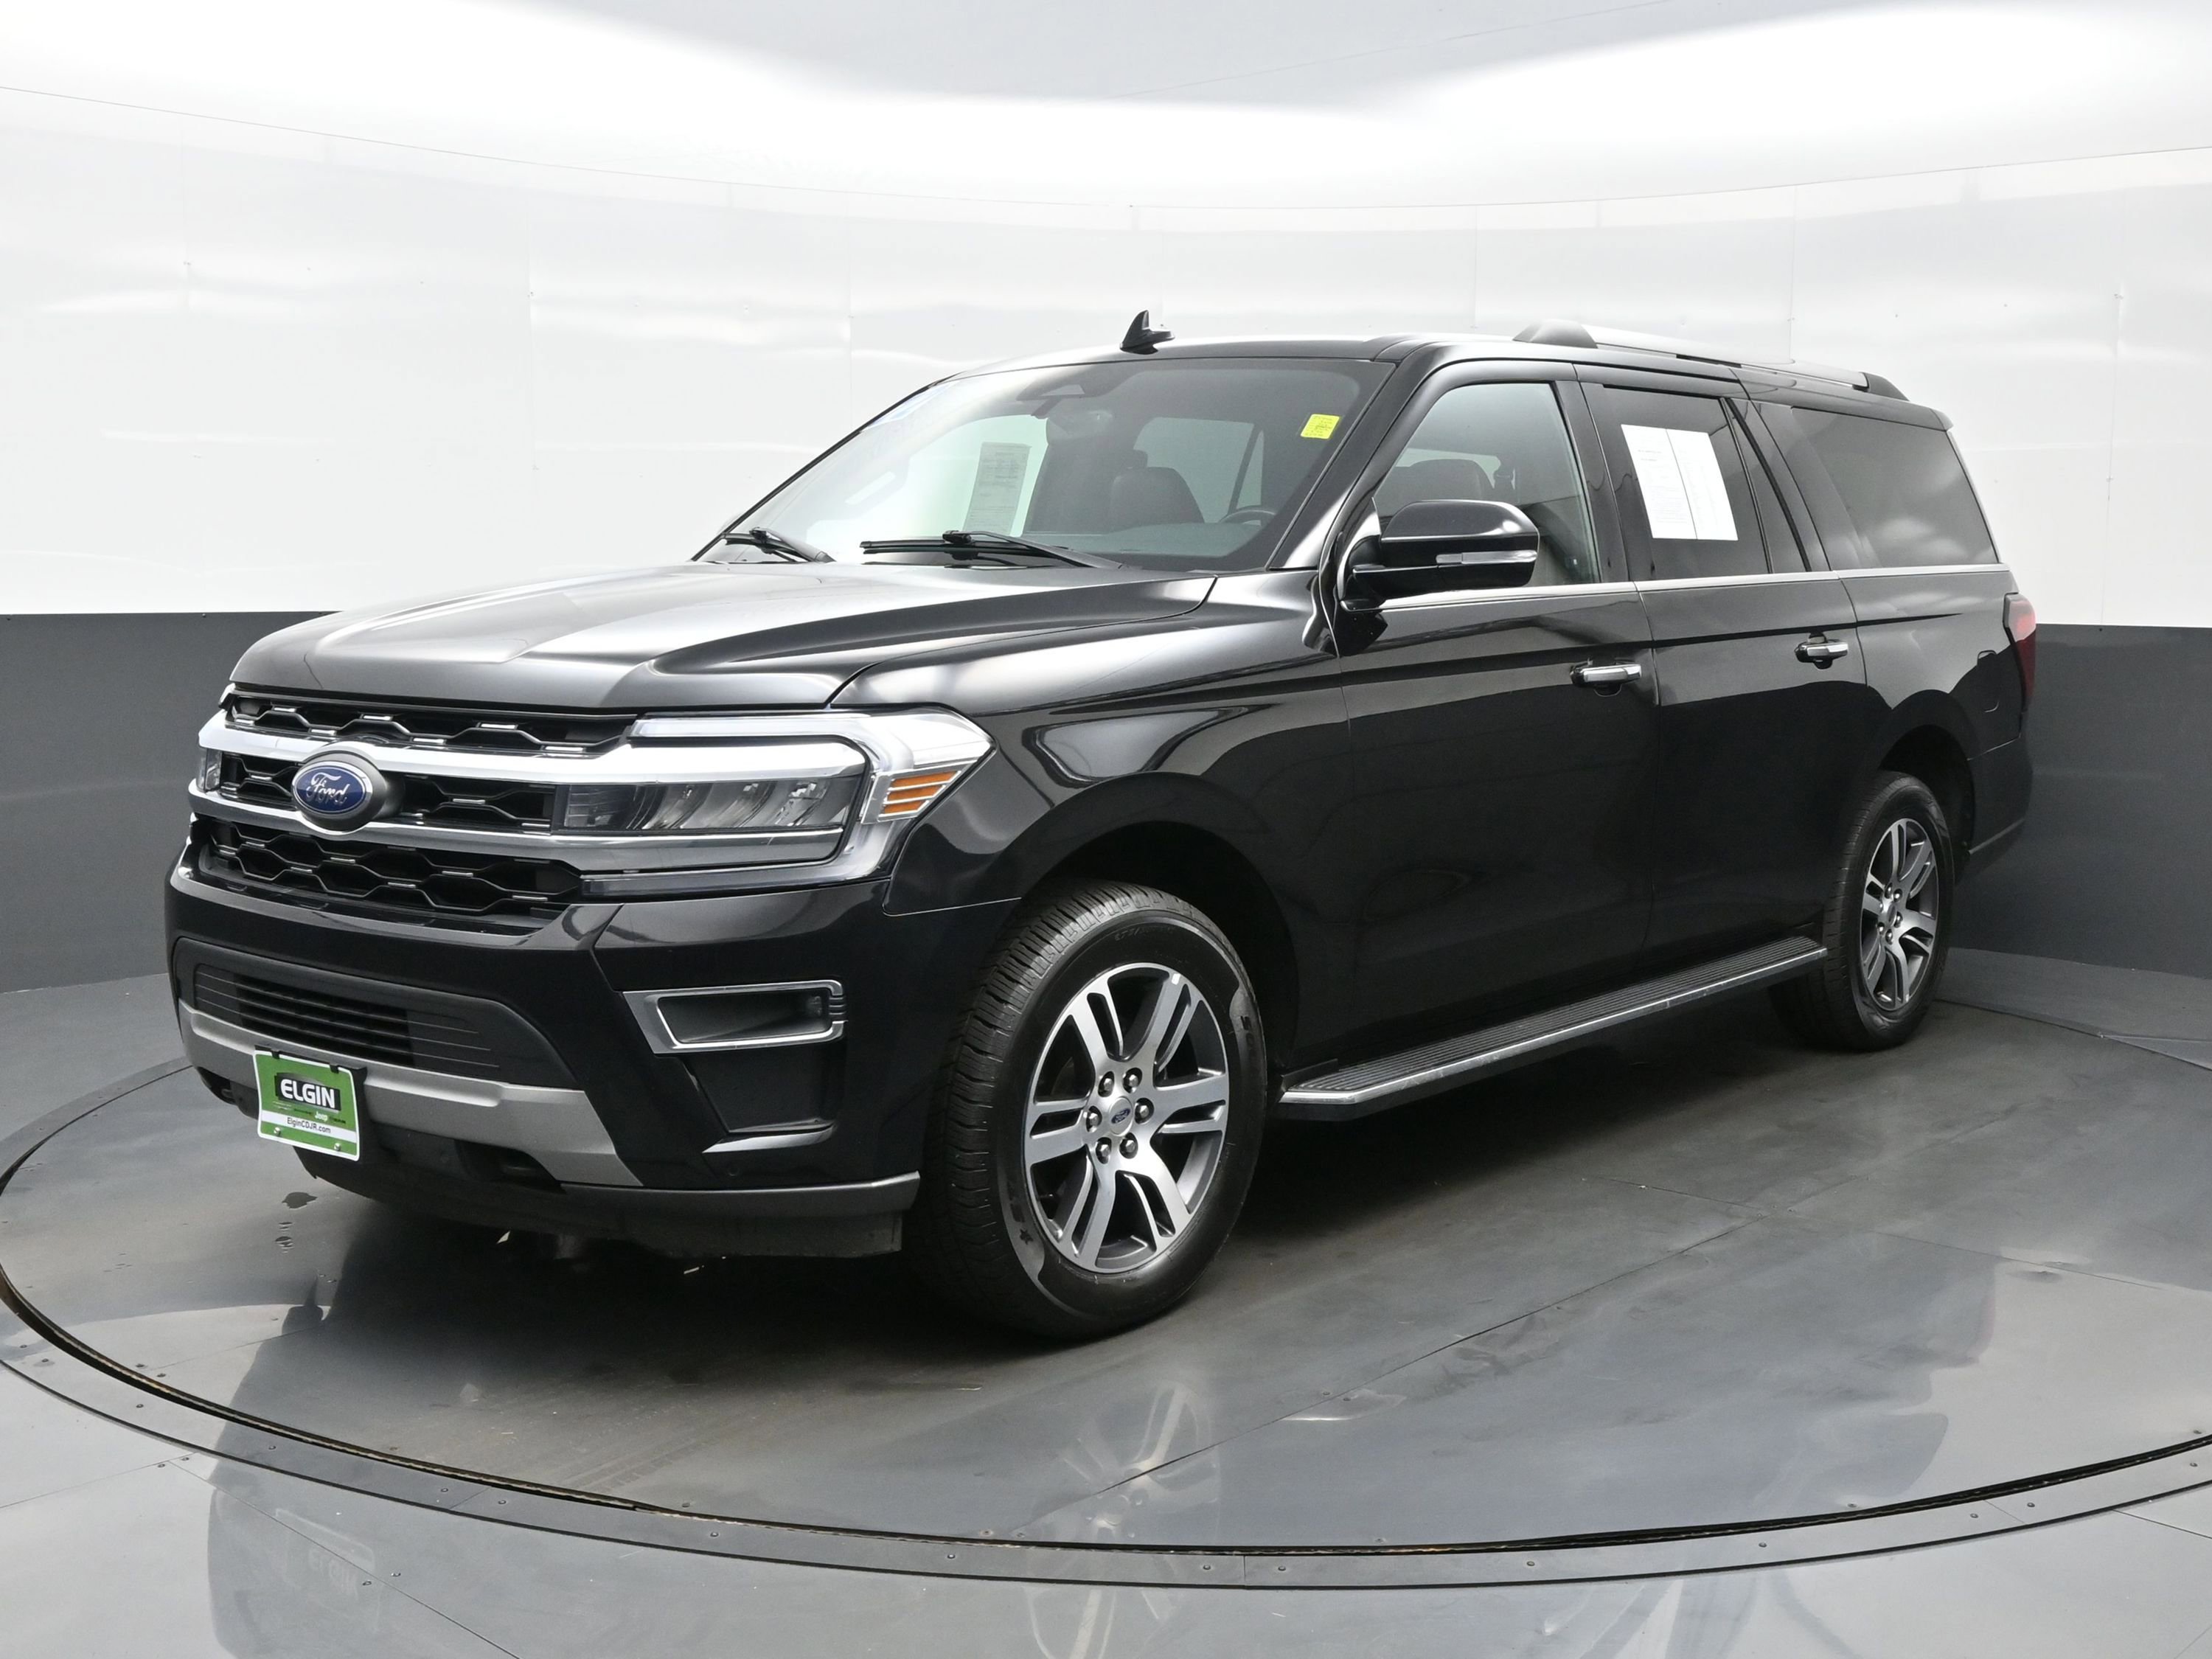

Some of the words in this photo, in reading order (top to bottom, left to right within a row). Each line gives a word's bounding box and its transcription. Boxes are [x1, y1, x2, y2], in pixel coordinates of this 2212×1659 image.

[305, 771, 351, 804] Ford
[281, 1078, 335, 1109] ELGIN
[287, 1117, 331, 1134] ElginCDJR.com
